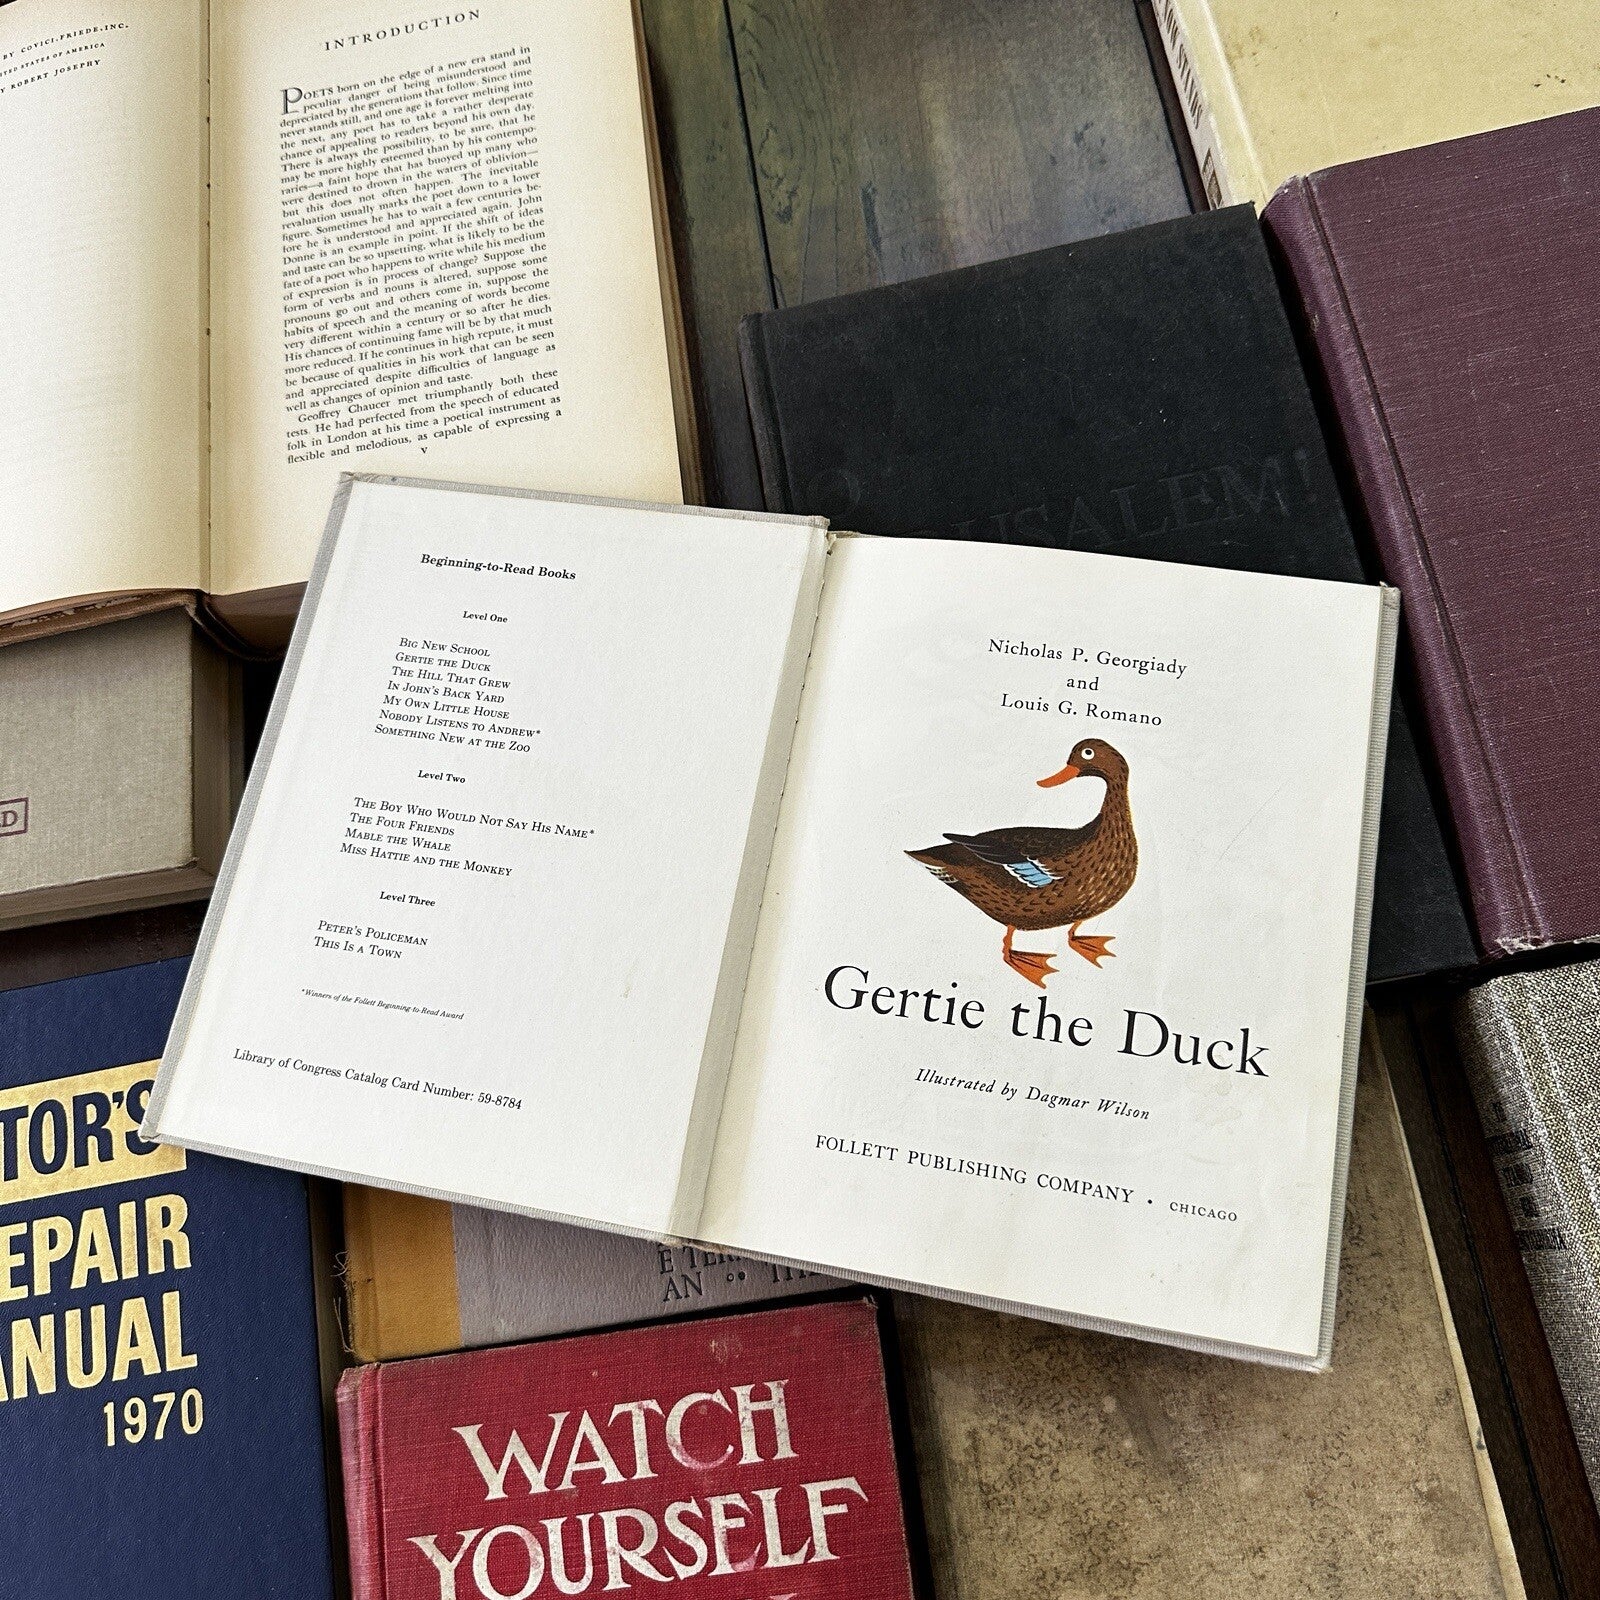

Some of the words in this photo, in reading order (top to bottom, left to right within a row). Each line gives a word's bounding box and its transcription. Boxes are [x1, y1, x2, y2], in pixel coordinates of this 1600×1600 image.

[324, 9, 480, 52] INTRODUCTION
[2, 51, 15, 61] BY
[20, 55, 50, 70] STATES
[52, 51, 63, 59] OF
[65, 42, 105, 55] AMERICA
[10, 71, 49, 90] ROBERT
[53, 59, 101, 77] JOSEPHY
[297, 409, 341, 423] Geoffrey
[347, 400, 391, 414] Chaucer
[397, 395, 418, 405] met
[424, 380, 494, 401] triumphantly
[499, 374, 525, 387] both
[531, 369, 558, 381] these
[315, 422, 332, 433] He
[334, 417, 355, 430] had
[358, 408, 406, 429] perfected
[409, 405, 436, 416] from
[439, 400, 457, 411] the
[460, 393, 494, 410] speech
[497, 389, 509, 400] of
[512, 380, 560, 398] educated
[287, 439, 307, 451] folk
[311, 437, 323, 447] in
[326, 430, 368, 444] London
[371, 427, 382, 436] at
[385, 423, 401, 434] his
[405, 419, 429, 430] time
[432, 418, 439, 426] a
[443, 407, 484, 427] poetical
[488, 398, 547, 415] instrument
[550, 396, 561, 404] as
[287, 449, 326, 465] flexible
[330, 444, 351, 457] and
[355, 436, 412, 452] melodious,
[417, 433, 428, 442] as
[433, 423, 473, 440] capable
[478, 419, 490, 431] of
[495, 411, 550, 428] expressing
[555, 409, 562, 417] a
[420, 553, 535, 576] Beginning-to-Read
[537, 566, 577, 580] Books
[462, 610, 488, 621] Level
[489, 613, 508, 623] One
[395, 651, 435, 665] GERTIE
[437, 658, 458, 668] THE
[460, 659, 491, 672] DUCK
[398, 637, 419, 649] BIG
[421, 639, 448, 652] NEW
[449, 643, 491, 657] SCHOOL
[988, 638, 1063, 660] Nicholas
[1071, 647, 1089, 663] P.
[1096, 650, 1188, 680] Georgiady
[387, 679, 401, 691] IN
[402, 682, 440, 696] JOHN'S
[442, 686, 471, 700] BACK
[475, 690, 505, 704] YARD
[391, 665, 415, 678] THE
[417, 668, 443, 682] HILL
[446, 672, 477, 685] THAT
[478, 676, 511, 689] GREW
[1066, 676, 1100, 691] and
[378, 709, 423, 724] NOBODY
[425, 714, 469, 730] LISTENS
[471, 722, 485, 732] TO
[382, 694, 402, 706] MY
[404, 697, 431, 709] OWN
[433, 700, 471, 715] LITTLE
[473, 705, 510, 720] HOUSE
[1000, 693, 1050, 713] Louis
[1057, 700, 1077, 716] G.
[1085, 702, 1162, 726] Romano
[374, 723, 436, 741] SOMETHING
[438, 731, 466, 744] NEW
[467, 738, 483, 747] AT
[484, 739, 506, 750] THE
[508, 740, 531, 753] ZOO
[417, 769, 444, 781] Level
[445, 773, 466, 784] Two
[349, 811, 373, 825] THE
[375, 815, 406, 830] FOUR
[408, 820, 455, 836] FRIENDS
[353, 796, 377, 810] THE
[379, 800, 403, 813] BOY
[407, 803, 433, 817] WHO
[437, 808, 476, 823] WOULD
[479, 813, 504, 827] NOT
[505, 817, 529, 830] SAY
[531, 820, 552, 834] HIS
[344, 827, 384, 842] MABLE
[386, 835, 408, 846] THE
[412, 836, 452, 852] WHALE
[339, 842, 368, 856] MISS
[369, 846, 411, 862] HATTIE
[412, 855, 436, 866] AND
[438, 858, 461, 869] THE
[463, 859, 513, 877] MONKEY
[379, 890, 407, 903] Level
[408, 894, 436, 907] Three
[314, 935, 341, 950] THIS
[342, 940, 355, 952] IS
[356, 945, 364, 954] A
[369, 944, 403, 959] TOWN
[317, 919, 363, 937] PETER'S
[364, 926, 429, 946] POLICEMAN
[332, 993, 343, 1003] of
[353, 996, 377, 1006] Follett
[439, 1010, 465, 1020] Award
[824, 965, 985, 1030] Gertie
[1010, 995, 1094, 1047] the
[1116, 1008, 1270, 1078] Duck
[233, 1048, 276, 1068] Library
[278, 1057, 292, 1068] of
[292, 1058, 342, 1078] Congress
[344, 1068, 389, 1089] Catalog
[391, 1076, 421, 1092] Card
[422, 1081, 474, 1102] Number:
[477, 1091, 522, 1110] 59-8784
[914, 1068, 997, 1093] Illustrated
[1000, 1081, 1018, 1102] by
[1024, 1085, 1090, 1109] Dagmar
[1096, 1098, 1150, 1120] Wilson
[815, 1134, 899, 1161] FOLLETT
[907, 1149, 1027, 1185] PUBLISHING
[1036, 1173, 1135, 1204] COMPANY
[1169, 1201, 1238, 1222] CHICAGO
[0, 1193, 192, 1302] EPAIR
[0, 1290, 199, 1400] NUAL
[103, 1387, 205, 1447] 1970
[451, 1378, 800, 1501] WATCH
[406, 1476, 869, 1600] YOURSELF
